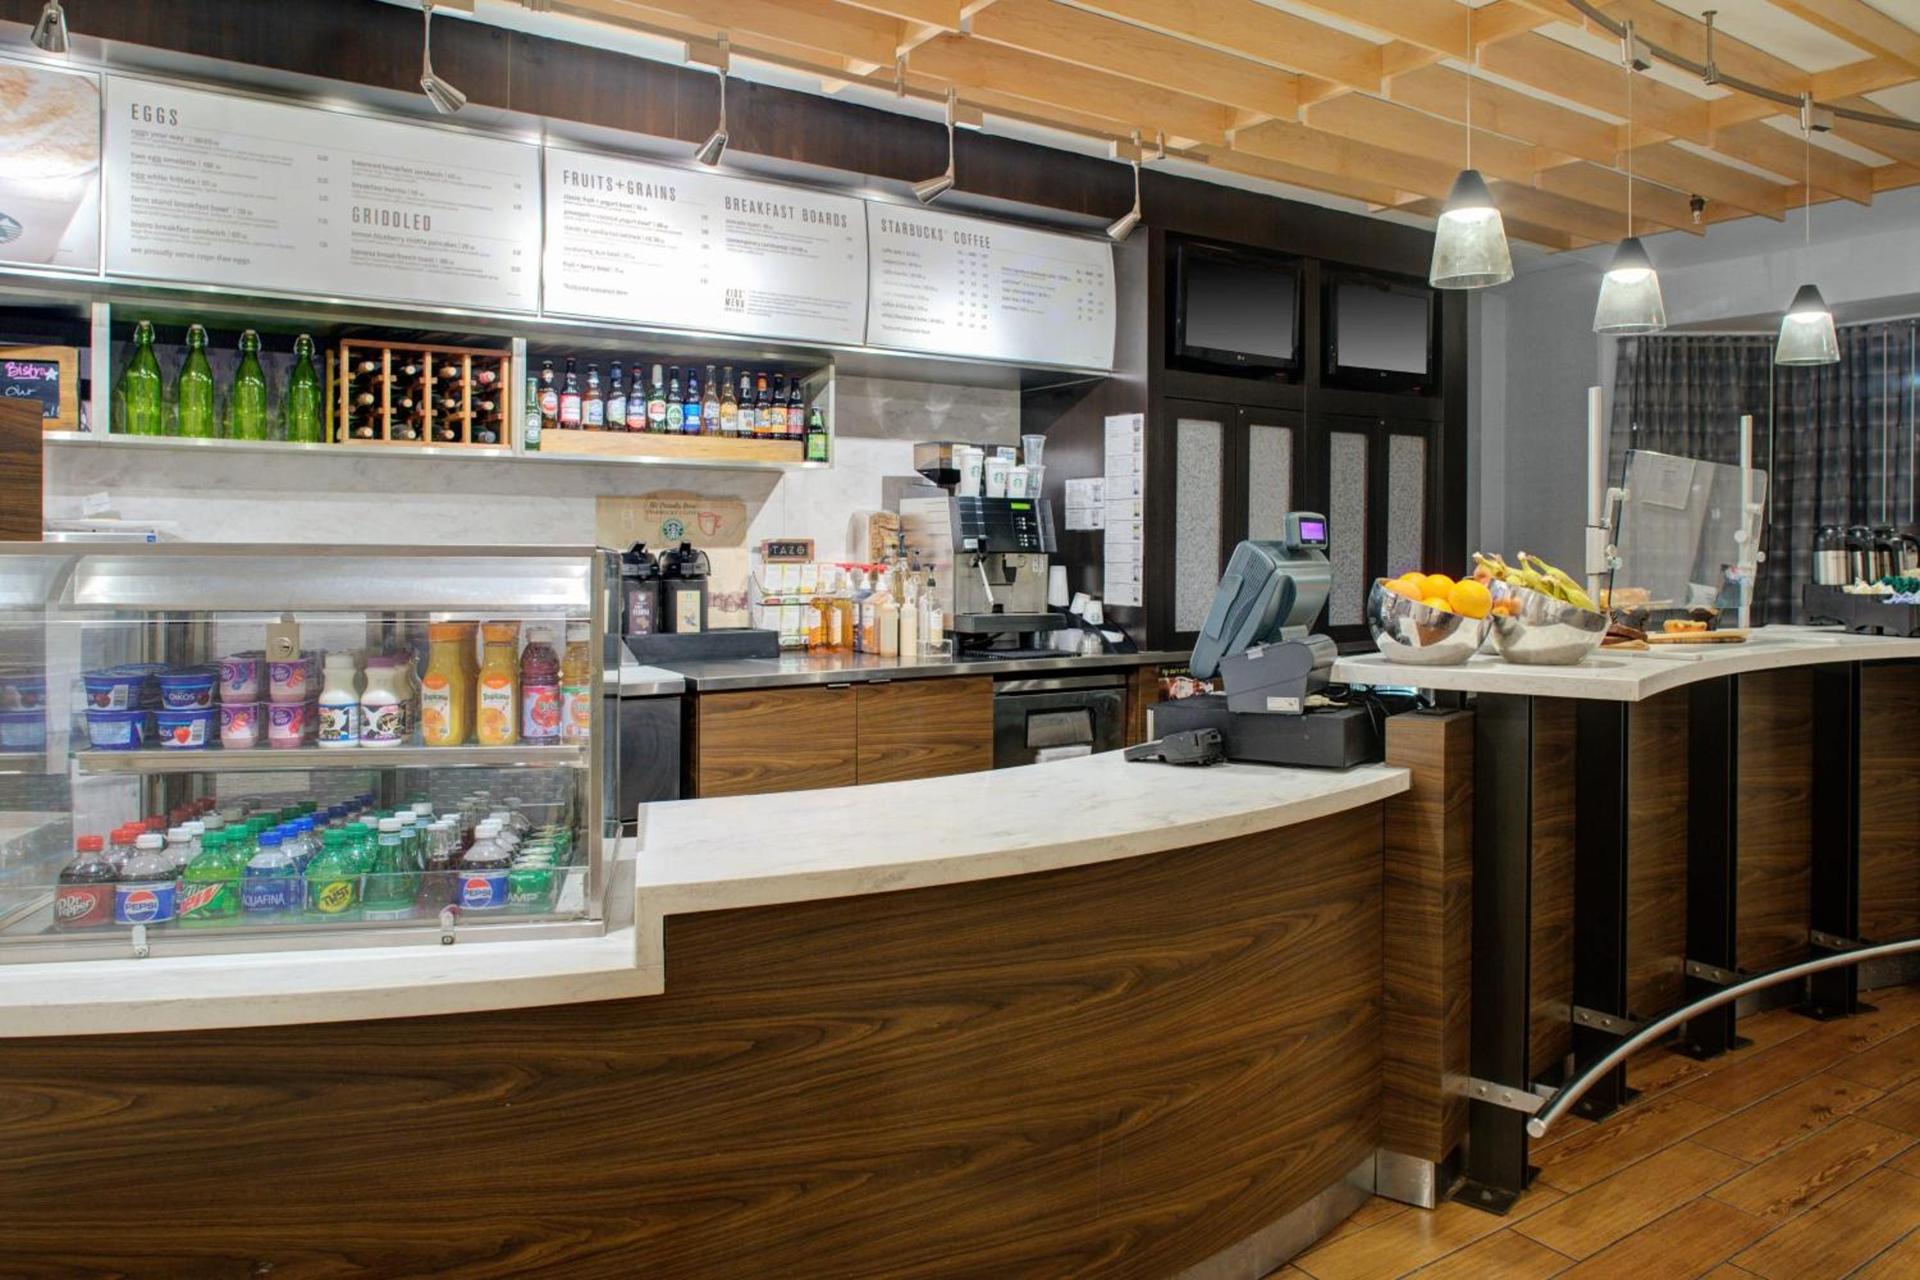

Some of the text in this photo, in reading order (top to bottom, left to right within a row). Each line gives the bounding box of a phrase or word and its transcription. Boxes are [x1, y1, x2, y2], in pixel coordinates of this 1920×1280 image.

[131, 102, 178, 126] EGGS
[352, 205, 432, 232] GRIDDLED
[725, 196, 848, 229] BREAKFAST BOARDS
[881, 217, 991, 249] STARBUCKS COFFEE
